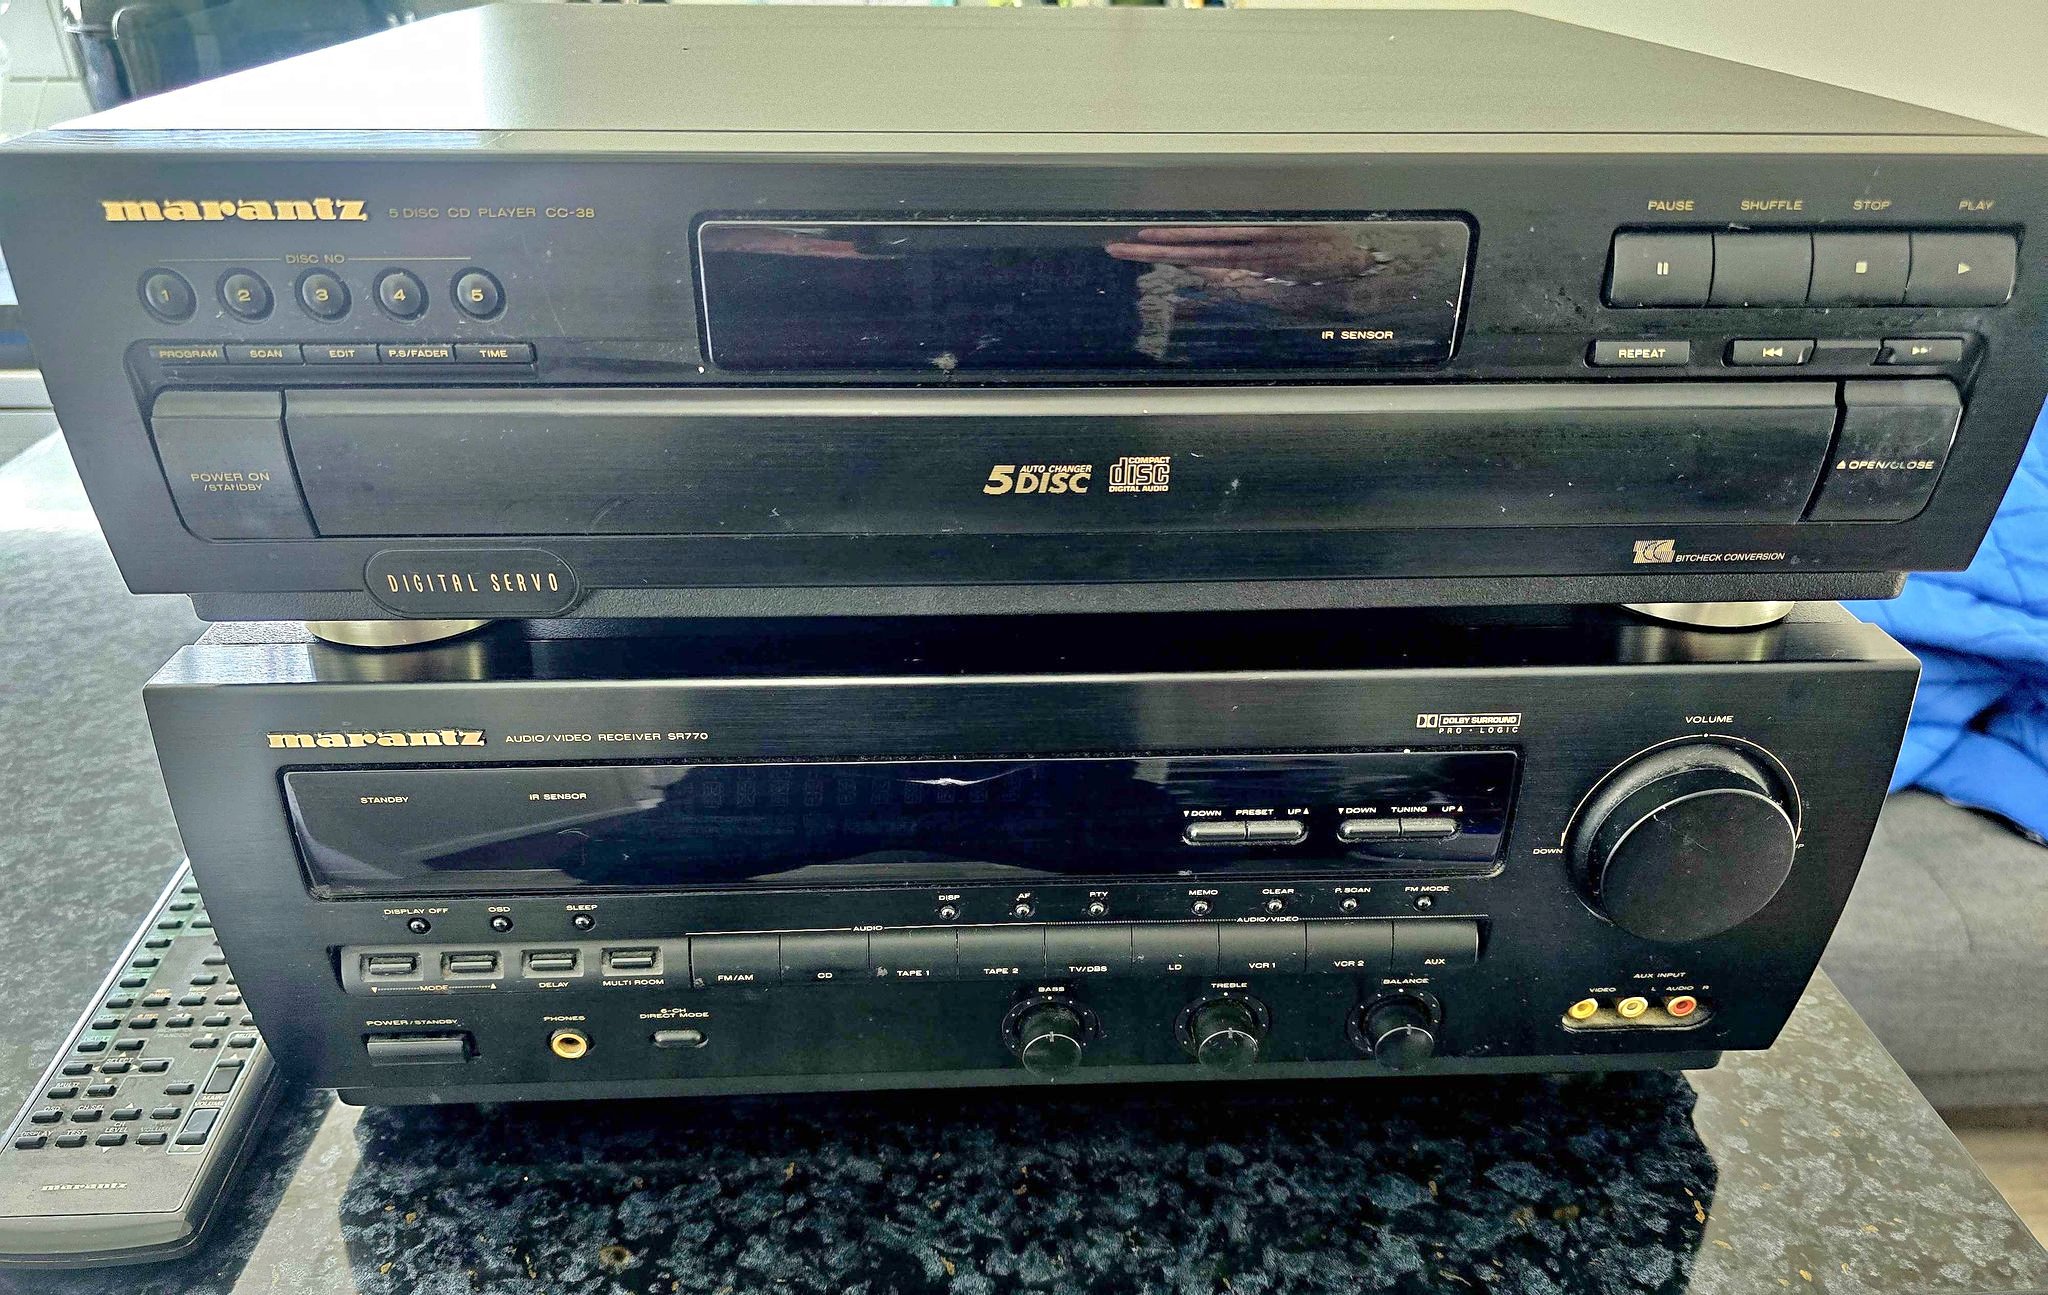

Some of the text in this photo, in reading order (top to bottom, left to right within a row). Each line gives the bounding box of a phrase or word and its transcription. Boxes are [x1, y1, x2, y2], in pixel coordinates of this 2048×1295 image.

[1648, 201, 1694, 210] PAUSE
[1741, 200, 1803, 210] SHUFFLE
[1853, 199, 1892, 210] STOP
[1959, 200, 1994, 210] PLAY
[101, 197, 367, 222] marantz
[389, 206, 594, 219] 5 DISC CD PLAYER CC-38
[286, 253, 346, 265] DISC NO
[162, 290, 169, 301] 1
[237, 289, 252, 301] 2
[314, 289, 328, 302] 3
[392, 289, 405, 301] 4
[471, 290, 484, 301] 5
[1322, 331, 1393, 339] IR SENSOR
[159, 350, 219, 358] PROGRAM
[250, 349, 282, 357] SCAN
[329, 349, 355, 357] EDIT
[1619, 349, 1666, 358] REPEAT
[1020, 465, 1092, 473] AUTO CHANGER
[1849, 461, 1934, 469] OPEN/CLOSE
[191, 472, 271, 481] POWER ON
[983, 465, 1015, 495] 5
[1015, 473, 1091, 493] DISC
[1109, 485, 1169, 493] DIGITAL AUDIO
[1676, 553, 1785, 562] BITCHECK CONVERSION
[387, 573, 557, 593] DIGITAL SERVO
[267, 730, 486, 748] marantz
[506, 734, 591, 742] AUDIO/VIDEO
[598, 733, 661, 741] RECEIVER
[361, 796, 408, 804] STANDBY
[1236, 808, 1274, 816] PRESET
[1442, 805, 1456, 813] UP
[1235, 915, 1299, 923] AUDIO/VIDEO
[1169, 963, 1182, 971] LD
[1333, 959, 1364, 968] VCR 2
[897, 969, 922, 977] TAPE
[984, 967, 1008, 975] TAPE
[1069, 965, 1107, 973] TV/DBS
[603, 978, 664, 987] MULTI ROOM
[1382, 977, 1429, 985] BALANCE
[418, 984, 450, 992] MODE
